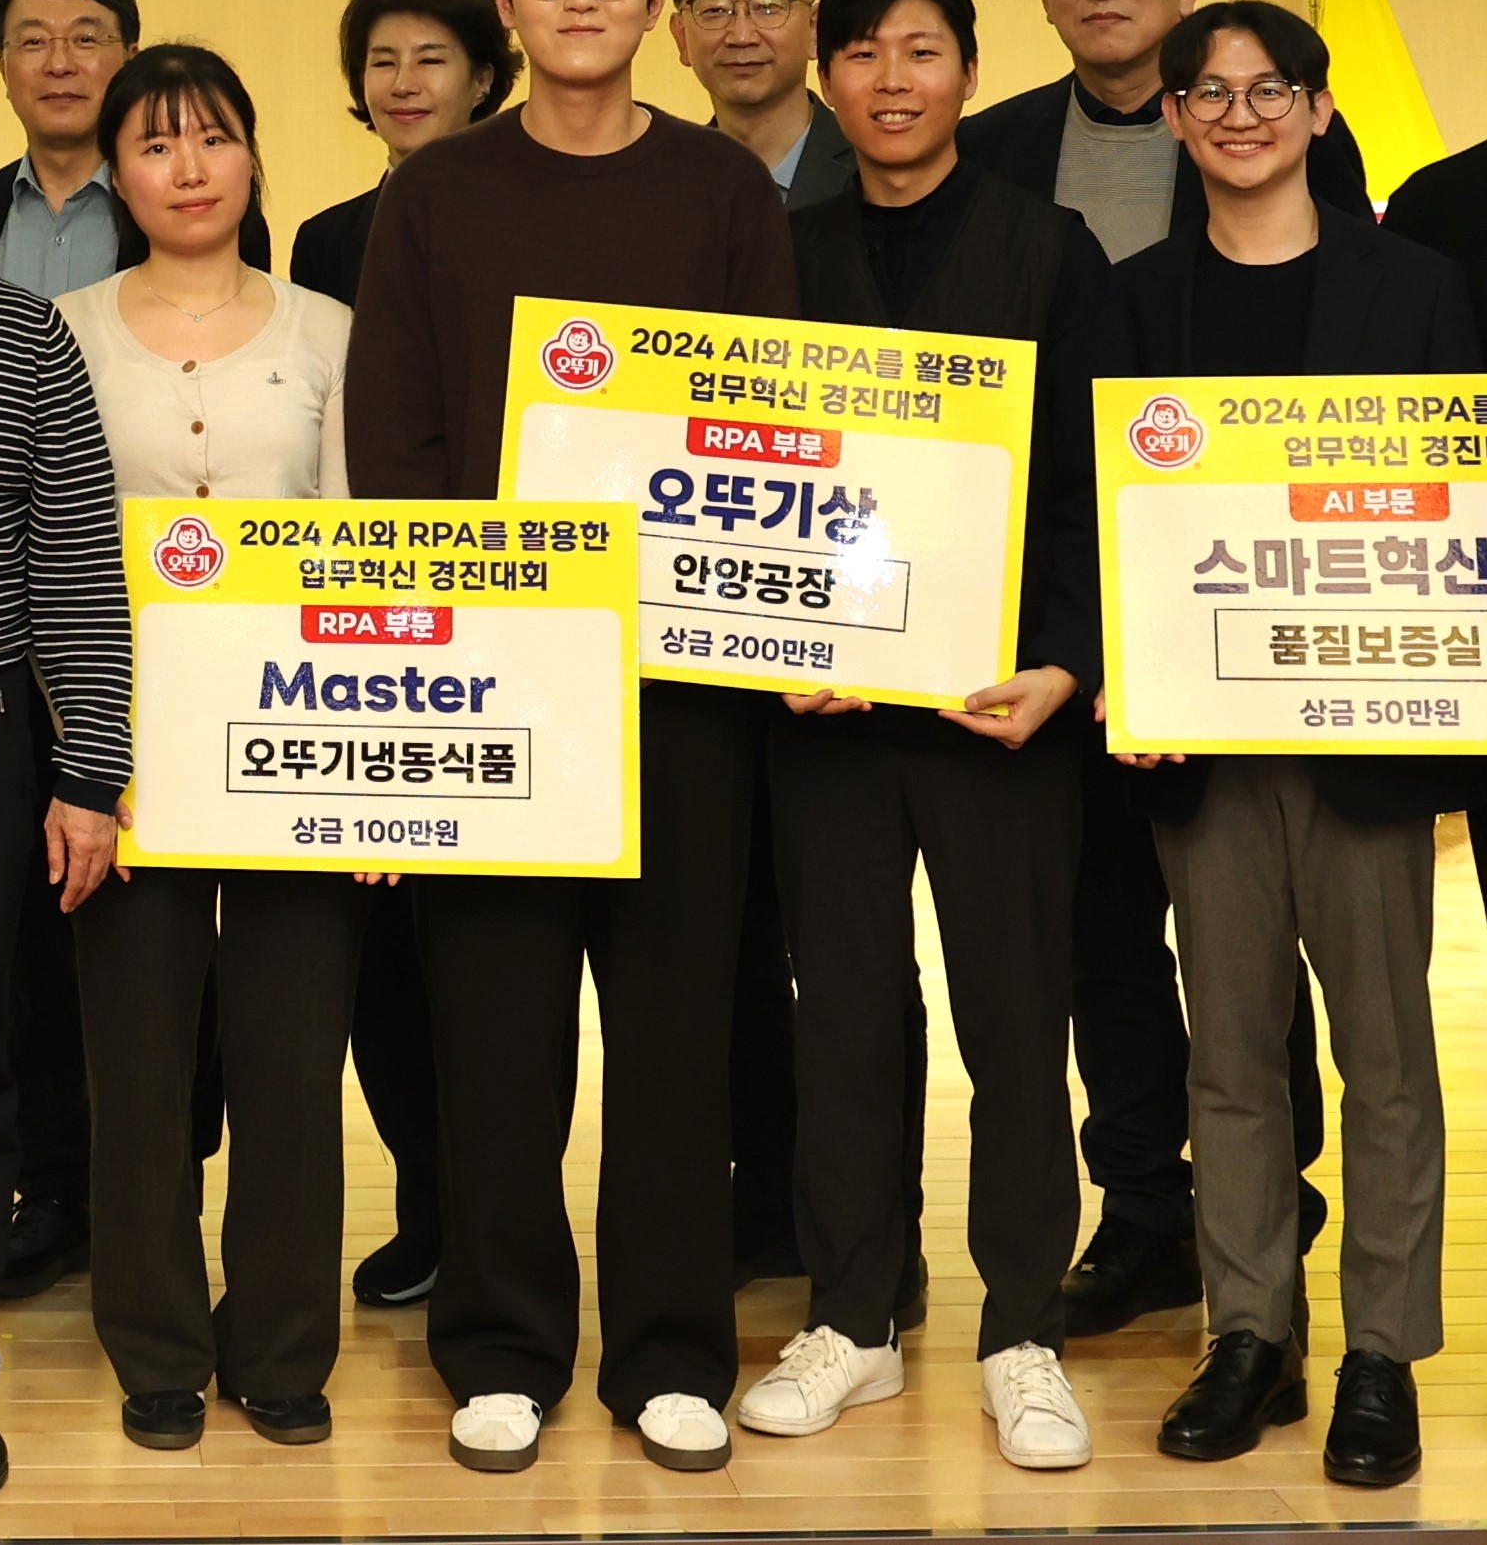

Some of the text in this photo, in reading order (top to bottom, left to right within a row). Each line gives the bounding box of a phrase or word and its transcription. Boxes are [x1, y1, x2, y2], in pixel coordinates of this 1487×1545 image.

[556, 357, 598, 376] 오뚜기
[631, 328, 1006, 388] 2024 AI와 RPA를 활용한
[689, 372, 941, 423] 업무혁신 경진대회
[1219, 398, 1306, 424] 2024
[1317, 396, 1385, 425] AI와
[705, 426, 822, 460] RPA 부문
[1144, 433, 1191, 454] 오뚜기
[1284, 436, 1408, 467] 업무혁신
[638, 469, 877, 543] 오뚜기상
[1323, 489, 1415, 515] AI 부문
[240, 520, 609, 551] 2024 AI와 RPA를 활용한
[169, 555, 211, 572] 오뚜기
[300, 559, 546, 591] 업무혁신 경진대회
[674, 554, 835, 608] 안양공장
[319, 607, 434, 638] RPA 부문
[661, 627, 833, 669] 상금 200만원
[1269, 625, 1481, 667] 품질보증실
[259, 661, 496, 713] Master
[1300, 699, 1459, 727] 상금 50만원
[242, 739, 516, 783] 오뚜기냉동식품
[292, 817, 458, 846] 상금 100만원
